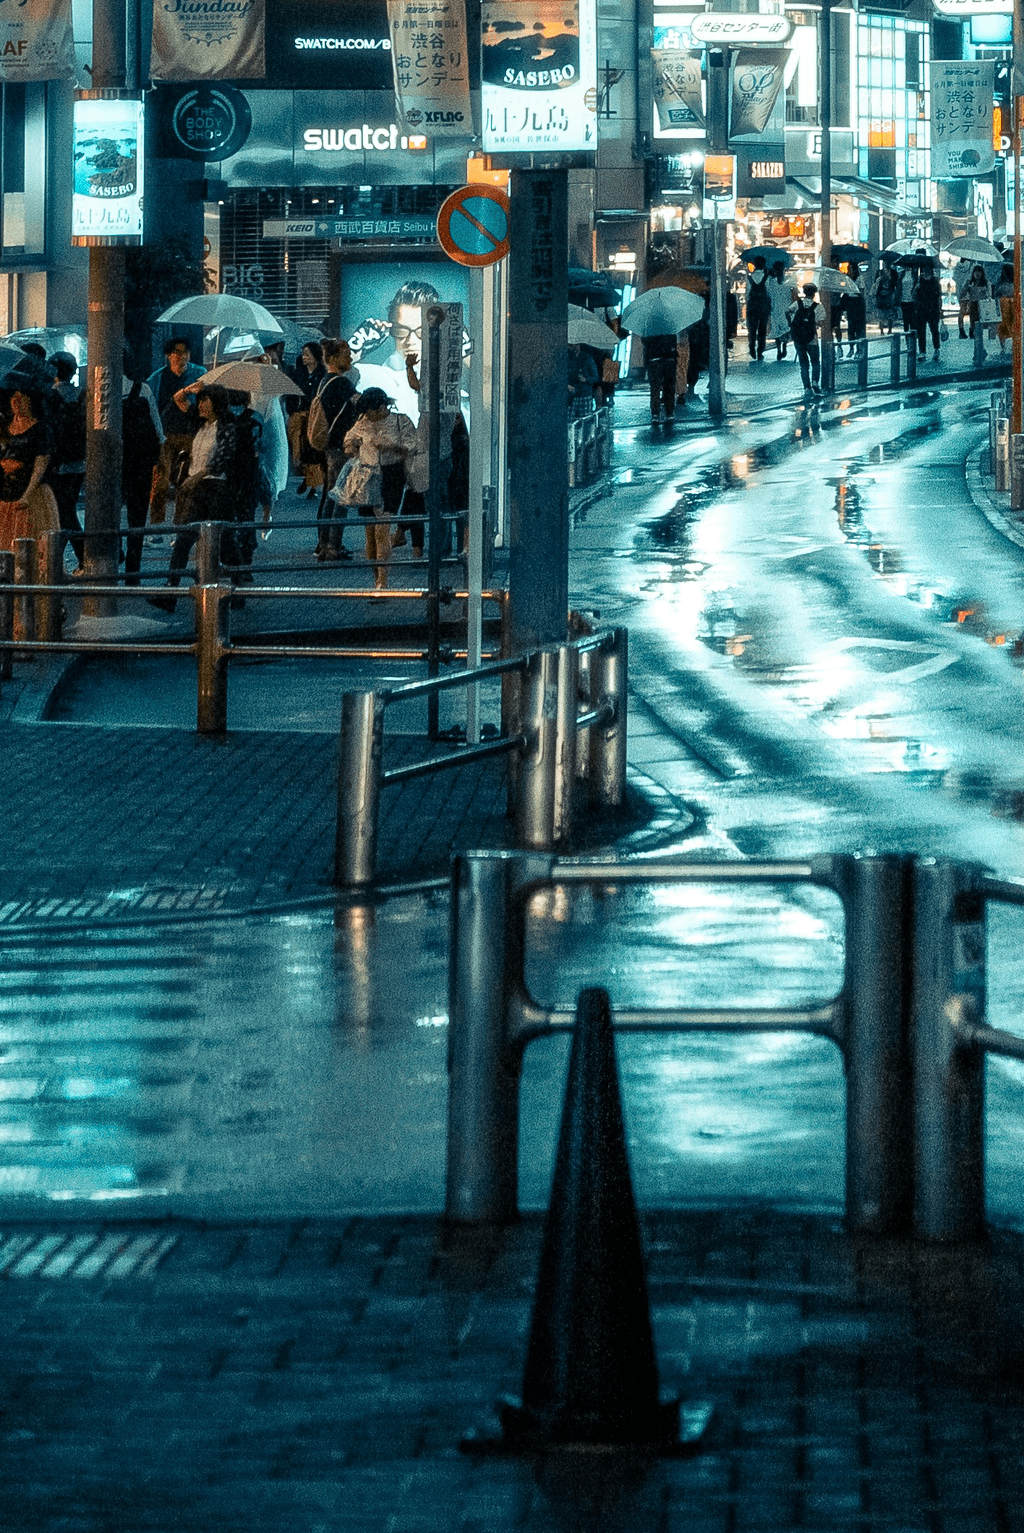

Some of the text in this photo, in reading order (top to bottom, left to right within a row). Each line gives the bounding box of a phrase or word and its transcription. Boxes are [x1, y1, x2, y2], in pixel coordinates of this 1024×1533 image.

[696, 21, 785, 33] 渋谷センター街
[411, 32, 446, 49] 渋谷
[397, 52, 462, 69] おとなり
[398, 71, 464, 89] サンデー
[503, 64, 575, 87] SASEBO
[946, 90, 976, 104] 渋谷
[194, 107, 215, 117] THE
[425, 111, 465, 123] XFLAG
[484, 105, 568, 133] 九十九島
[935, 105, 988, 120] おとなり
[186, 118, 223, 129] BODY
[936, 120, 990, 137] サンデー
[187, 130, 222, 141] SHOP
[89, 182, 134, 196] SASEBO
[285, 223, 314, 233] KEIO
[334, 221, 401, 235] 西武百貨店
[403, 222, 427, 233] Seibu
[222, 264, 264, 286] BIG
